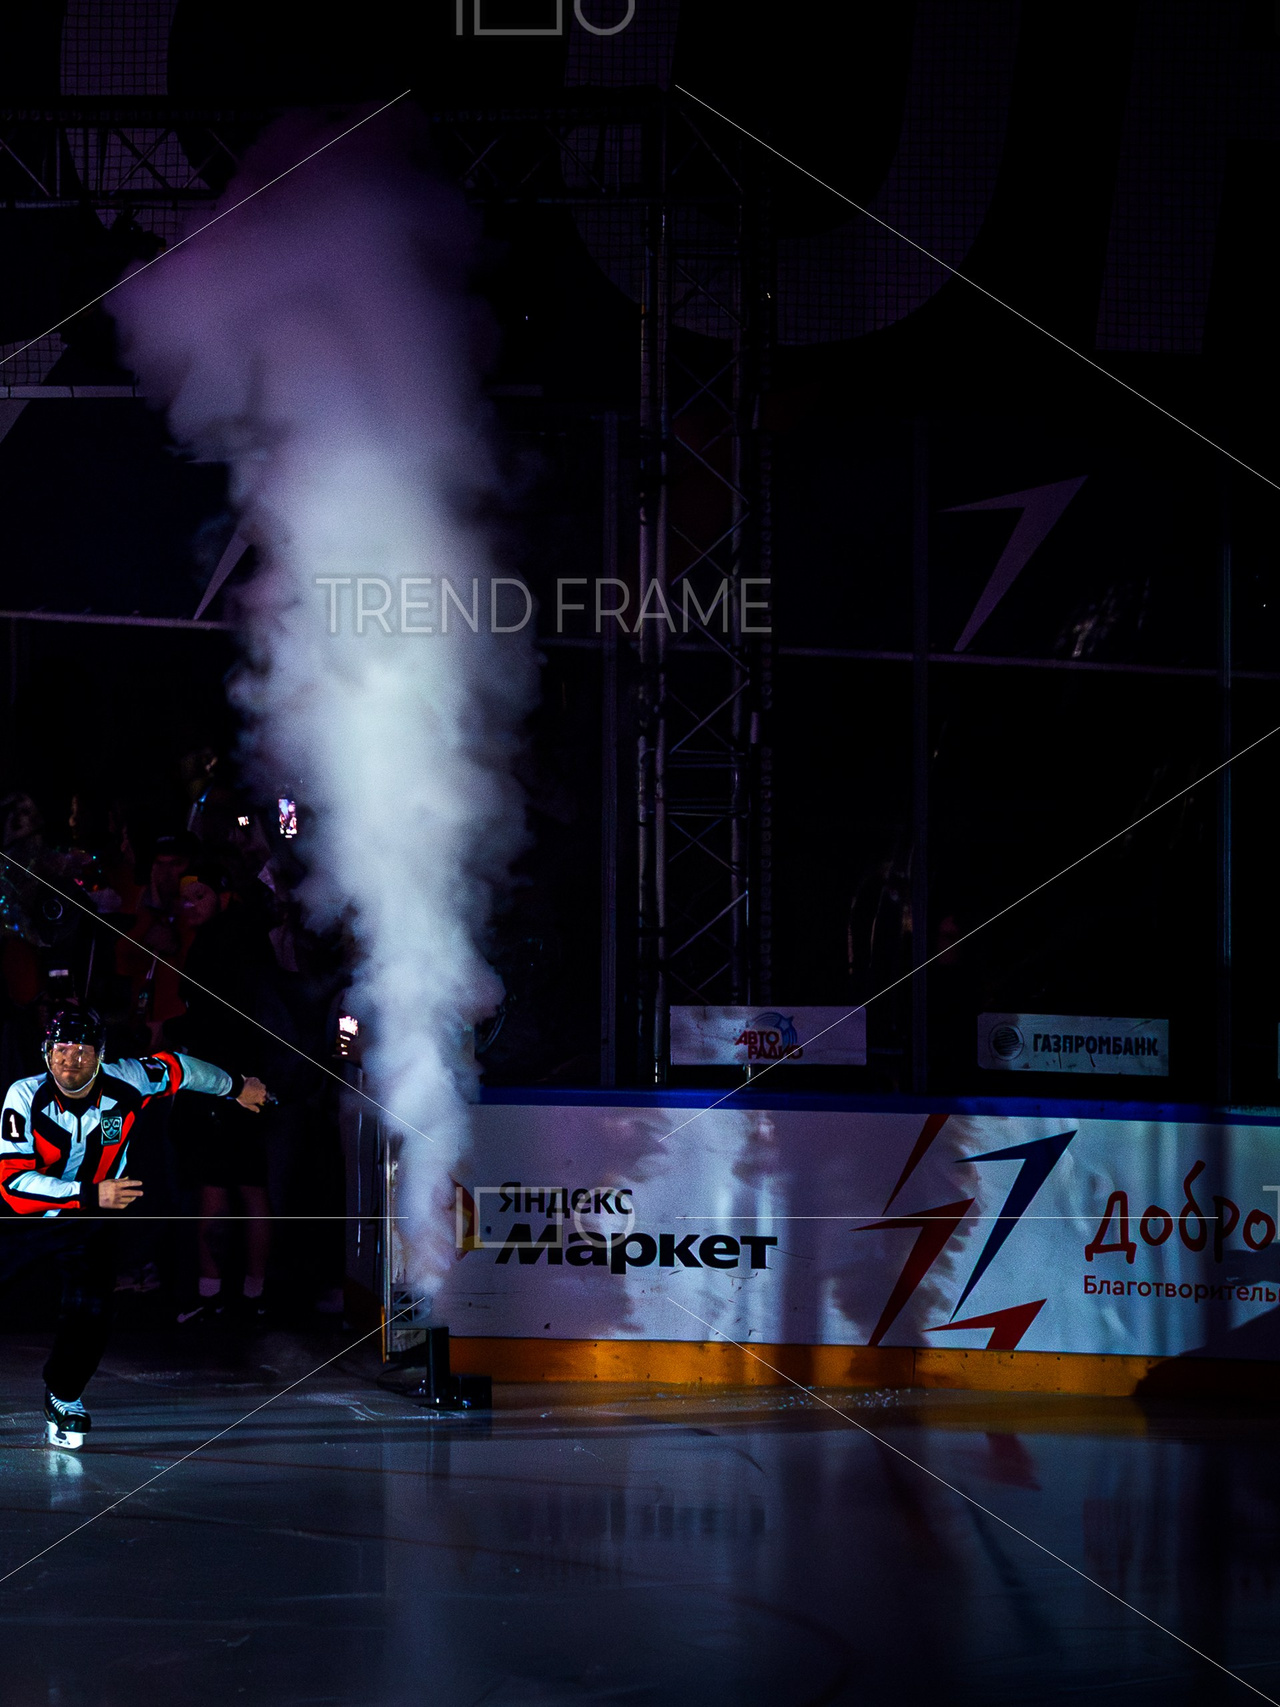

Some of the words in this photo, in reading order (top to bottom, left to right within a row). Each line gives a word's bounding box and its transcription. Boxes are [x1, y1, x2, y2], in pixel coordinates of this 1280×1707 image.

[1033, 1033, 1159, 1056] ГАЗПРОМБАНК
[9, 1114, 20, 1138] 1
[498, 1181, 634, 1219] Яндекс
[494, 1223, 778, 1275] Маркет
[1083, 1274, 1280, 1303] Благотворитель
